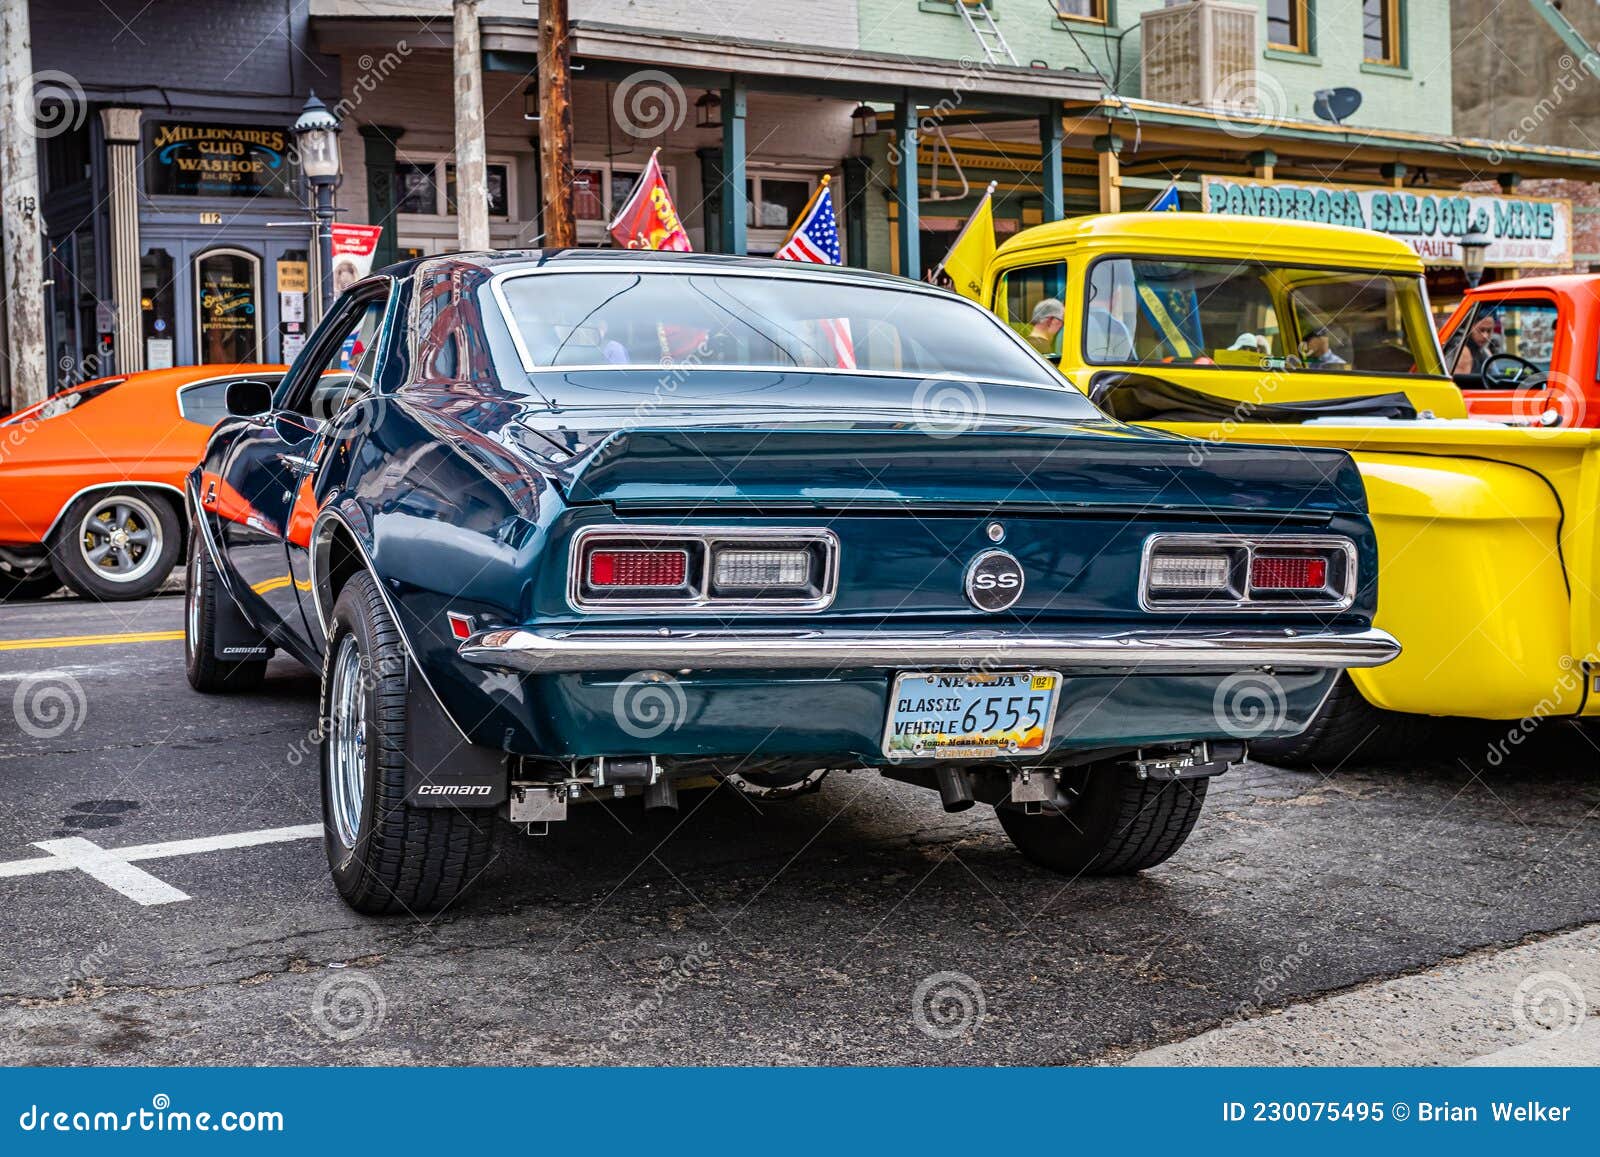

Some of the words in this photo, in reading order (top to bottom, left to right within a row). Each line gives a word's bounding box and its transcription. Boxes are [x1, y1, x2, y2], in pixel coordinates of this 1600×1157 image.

[154, 126, 284, 151] MILLIONAIRES
[198, 141, 245, 155] CLUB
[176, 158, 264, 173] WASHOE
[202, 213, 220, 224] 112
[1208, 183, 1366, 230] PONDEROSA
[1371, 193, 1471, 236] SALOON
[1493, 199, 1555, 240] MINE
[1413, 240, 1455, 258] VAULT
[974, 573, 1019, 589] SS
[1035, 677, 1047, 686] 02
[897, 698, 961, 713] CLASSIC
[961, 696, 1044, 734] 6555
[895, 720, 959, 736] VEHICLE
[949, 738, 976, 747] Means
[978, 737, 1009, 747] Nevada
[418, 784, 493, 796] camaro
